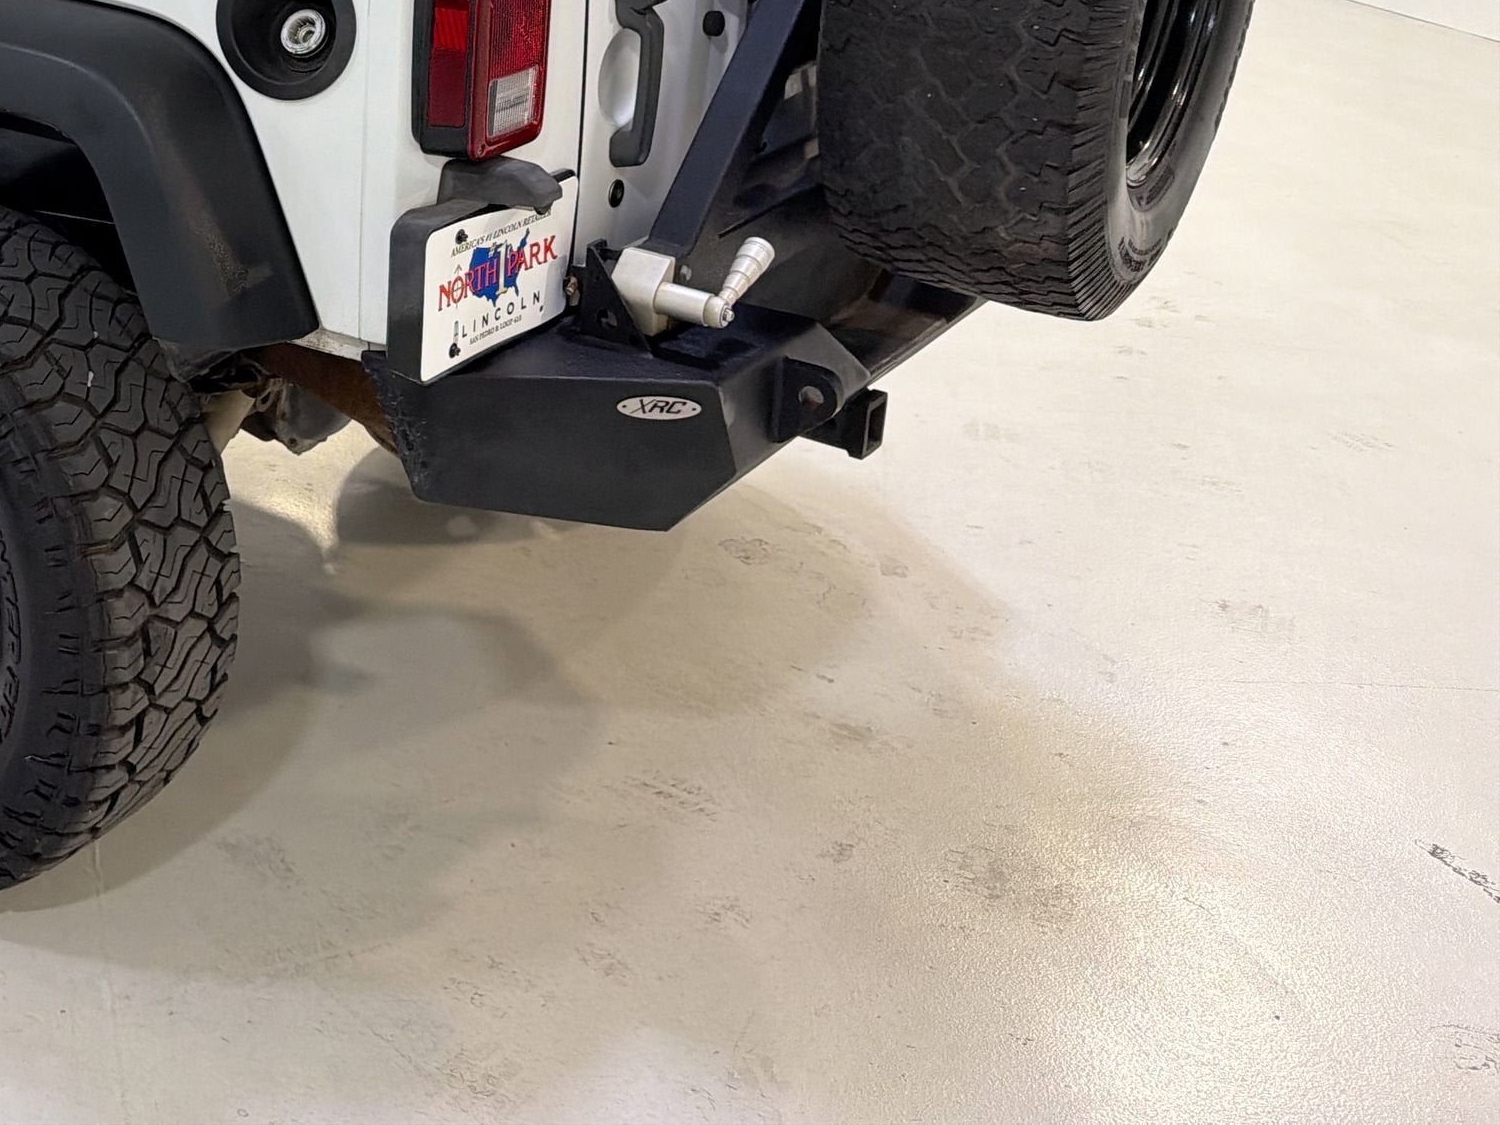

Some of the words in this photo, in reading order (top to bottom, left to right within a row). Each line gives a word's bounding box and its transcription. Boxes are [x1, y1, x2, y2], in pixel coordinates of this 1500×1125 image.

[493, 220, 522, 239] LINCOLN
[438, 258, 499, 312] NORTH
[507, 235, 558, 277] PARK
[462, 291, 540, 338] LINCOLN
[632, 398, 685, 415] XRC
